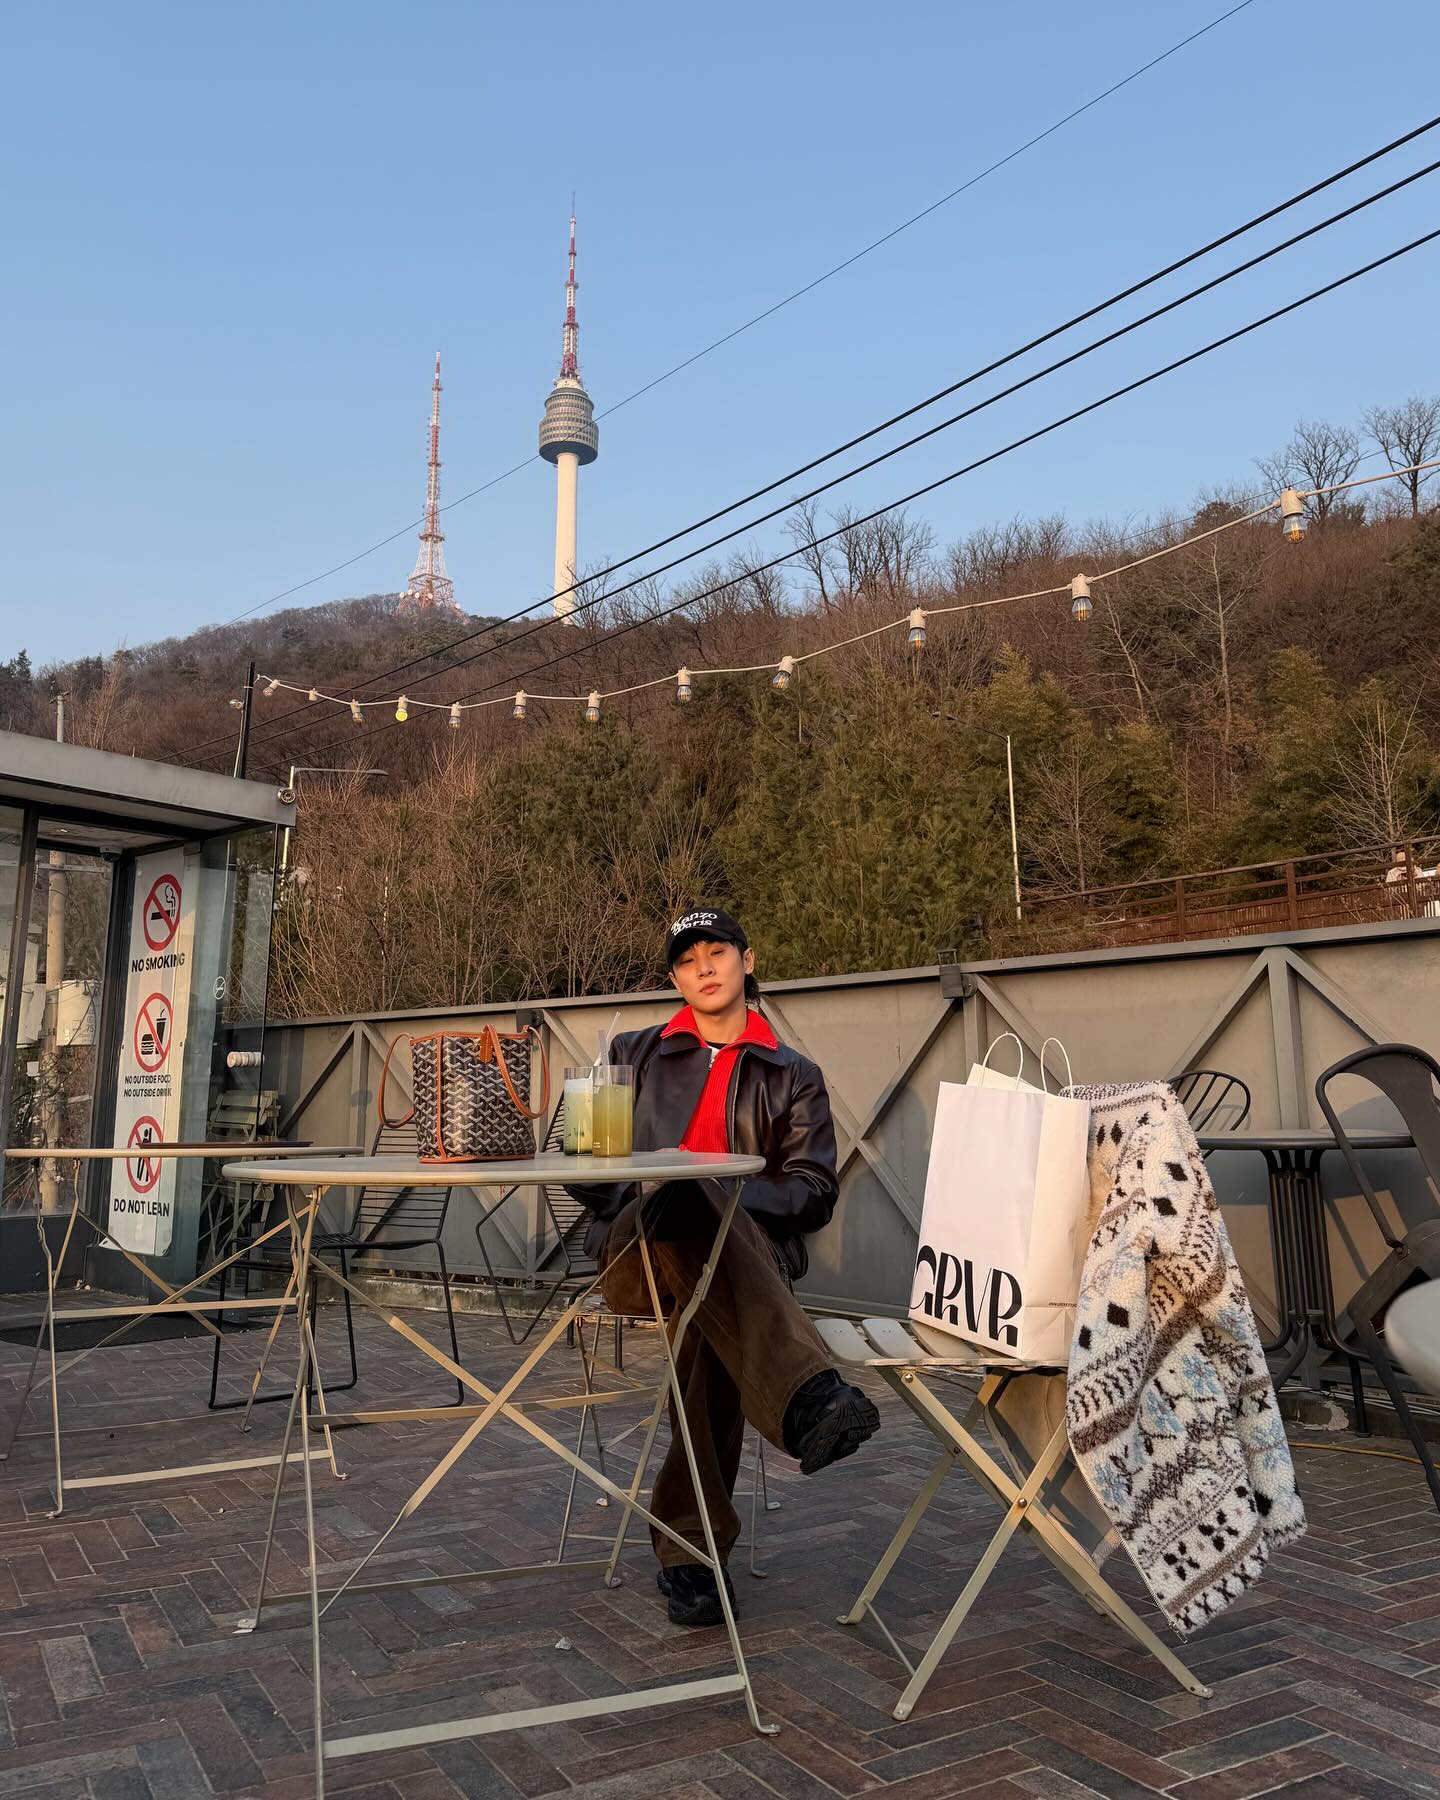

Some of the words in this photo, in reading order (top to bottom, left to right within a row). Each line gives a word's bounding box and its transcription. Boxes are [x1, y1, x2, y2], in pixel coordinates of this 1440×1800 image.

[131, 958, 145, 973] NO
[145, 952, 185, 971] SMOKING
[125, 1075, 133, 1084] NO
[133, 1074, 157, 1084] OUTSIDE
[157, 1074, 172, 1084] FOOD
[124, 1088, 132, 1097] NO
[132, 1088, 156, 1097] OUTSIDE
[113, 1198, 126, 1212] DO
[128, 1199, 146, 1215] NOT
[147, 1201, 170, 1217] LEAN
